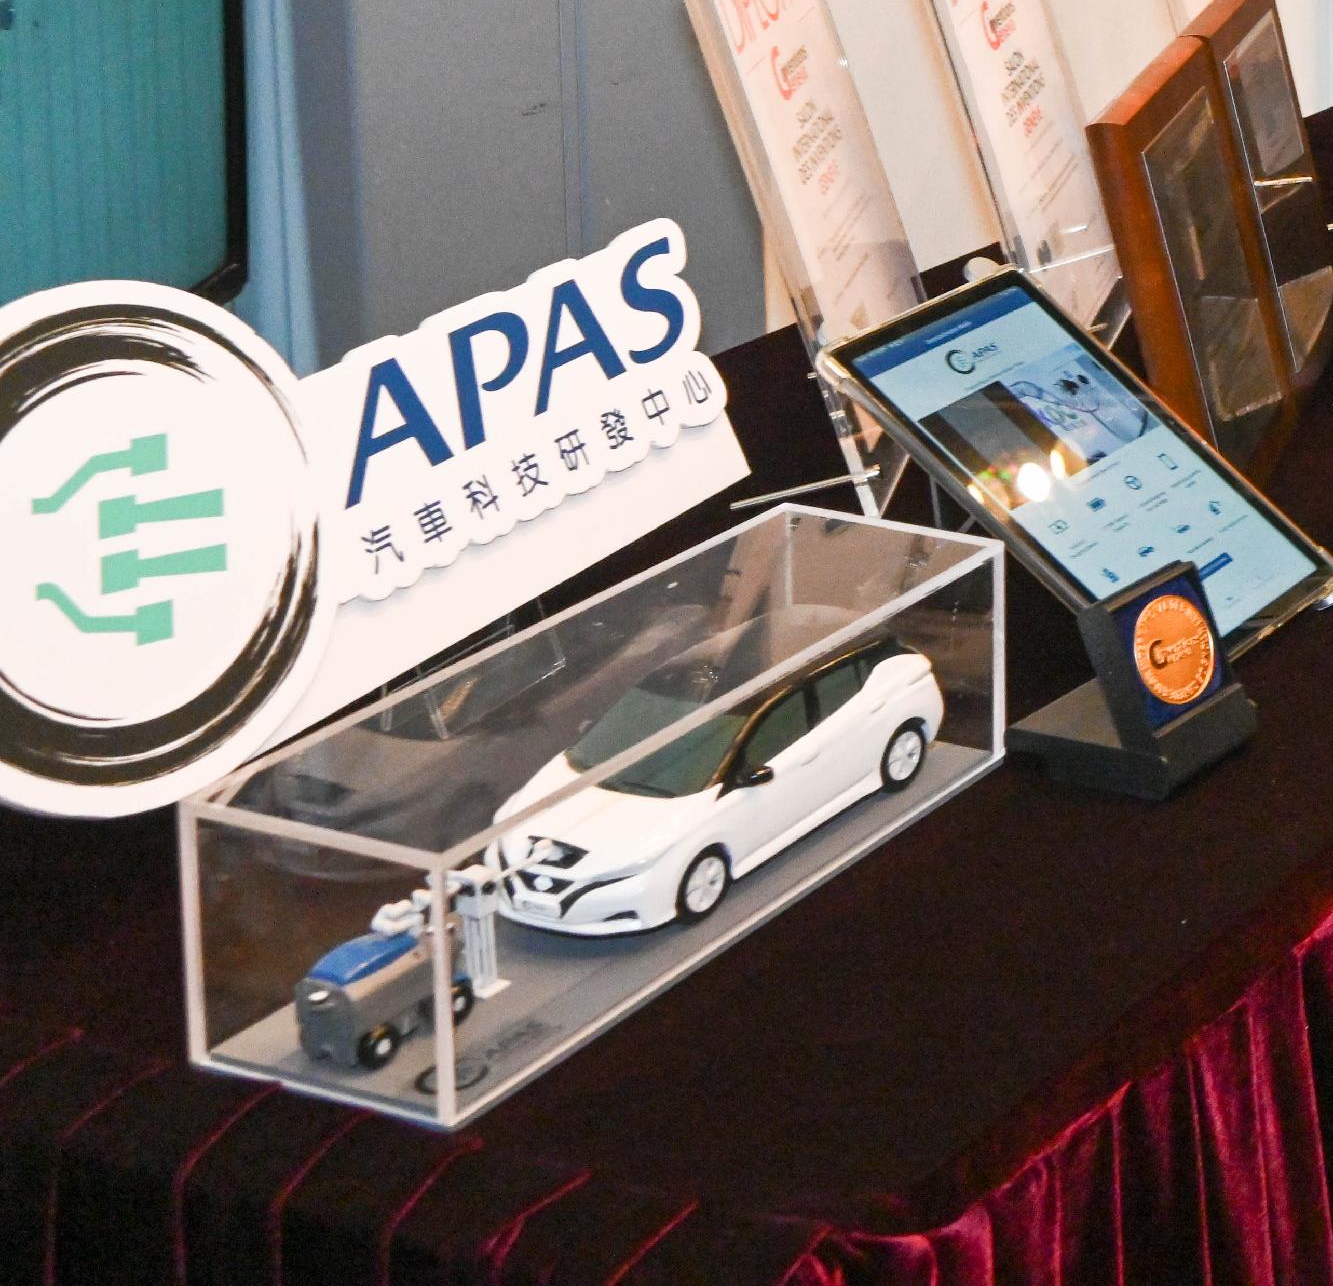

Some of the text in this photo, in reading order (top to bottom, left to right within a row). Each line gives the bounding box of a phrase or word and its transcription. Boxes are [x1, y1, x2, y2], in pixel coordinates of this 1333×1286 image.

[345, 236, 690, 510] APAS
[362, 367, 713, 576] 汽車科技研發中心
